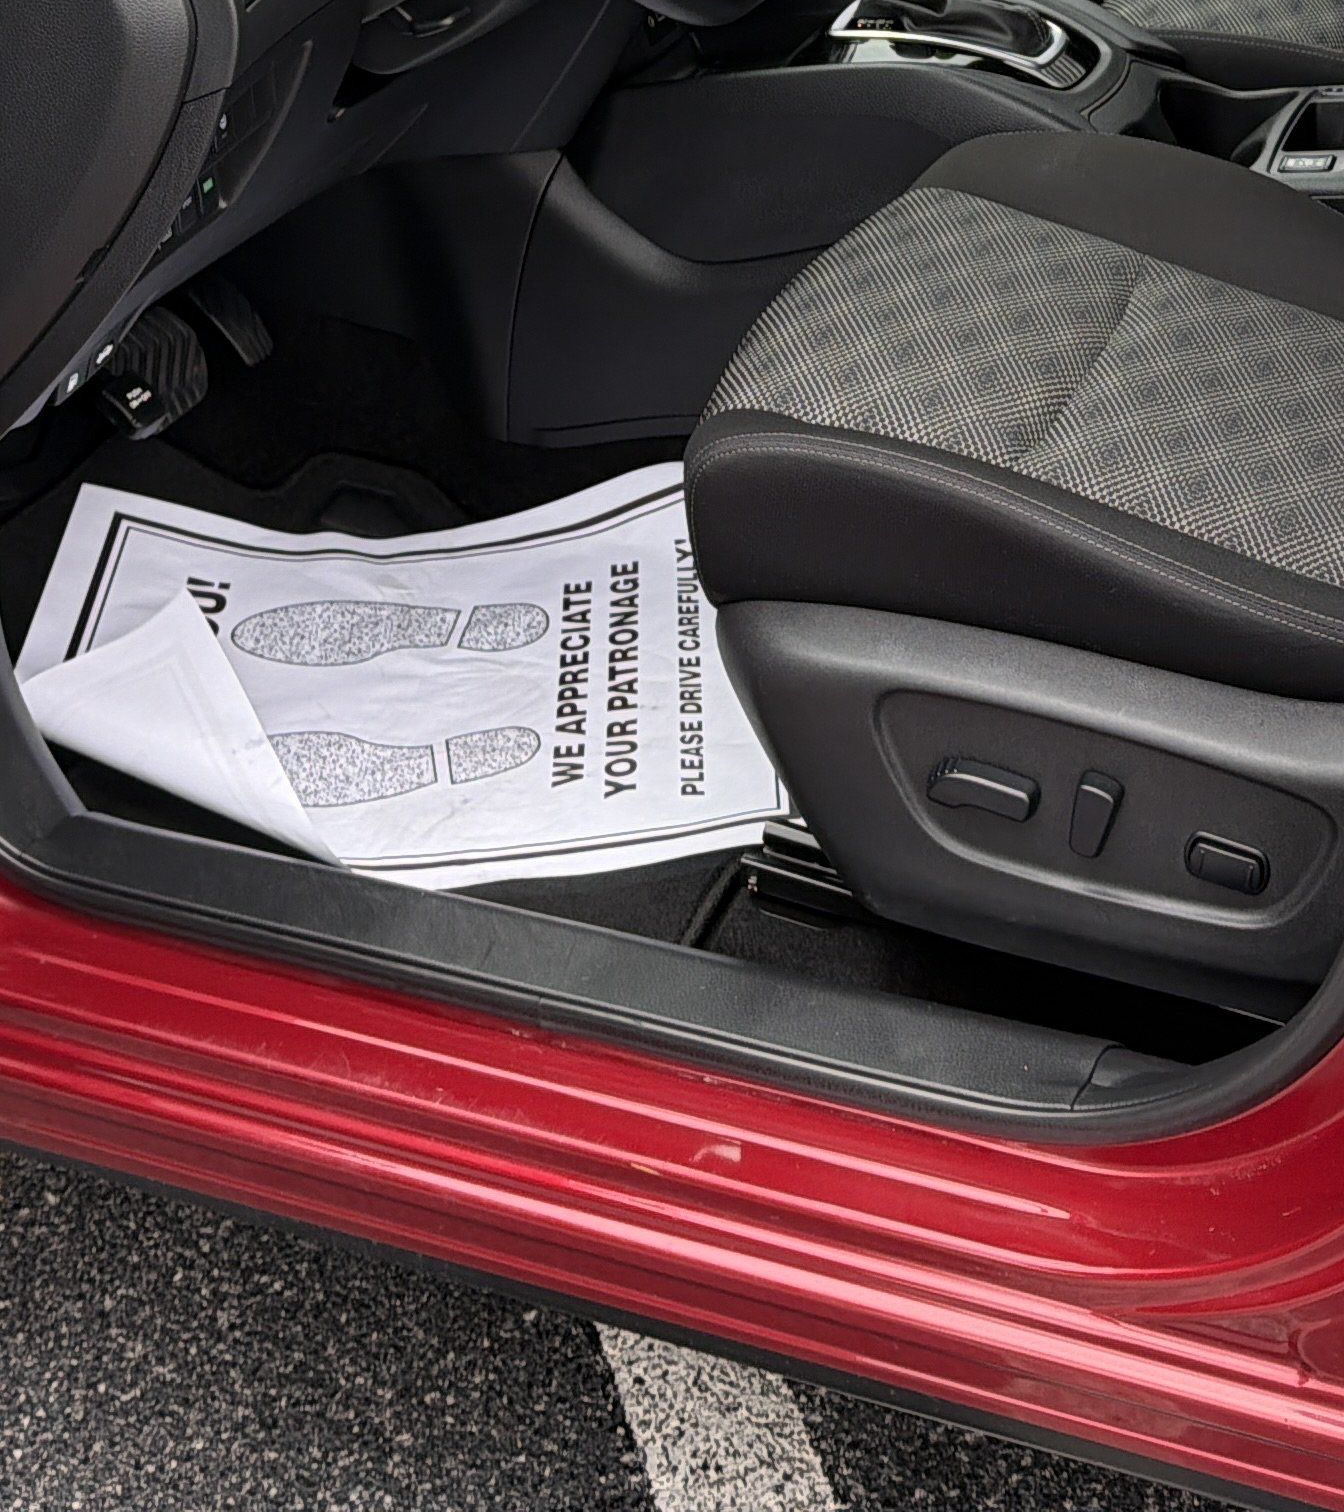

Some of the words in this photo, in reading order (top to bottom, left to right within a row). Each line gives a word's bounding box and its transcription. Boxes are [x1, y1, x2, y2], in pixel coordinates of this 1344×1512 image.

[555, 580, 593, 736] APPRECIATE
[606, 560, 640, 712] PATRONAGE
[678, 655, 702, 714] DRIVE
[551, 743, 586, 788] WE
[603, 718, 639, 800] YOUR
[679, 719, 706, 797] PLEASE
